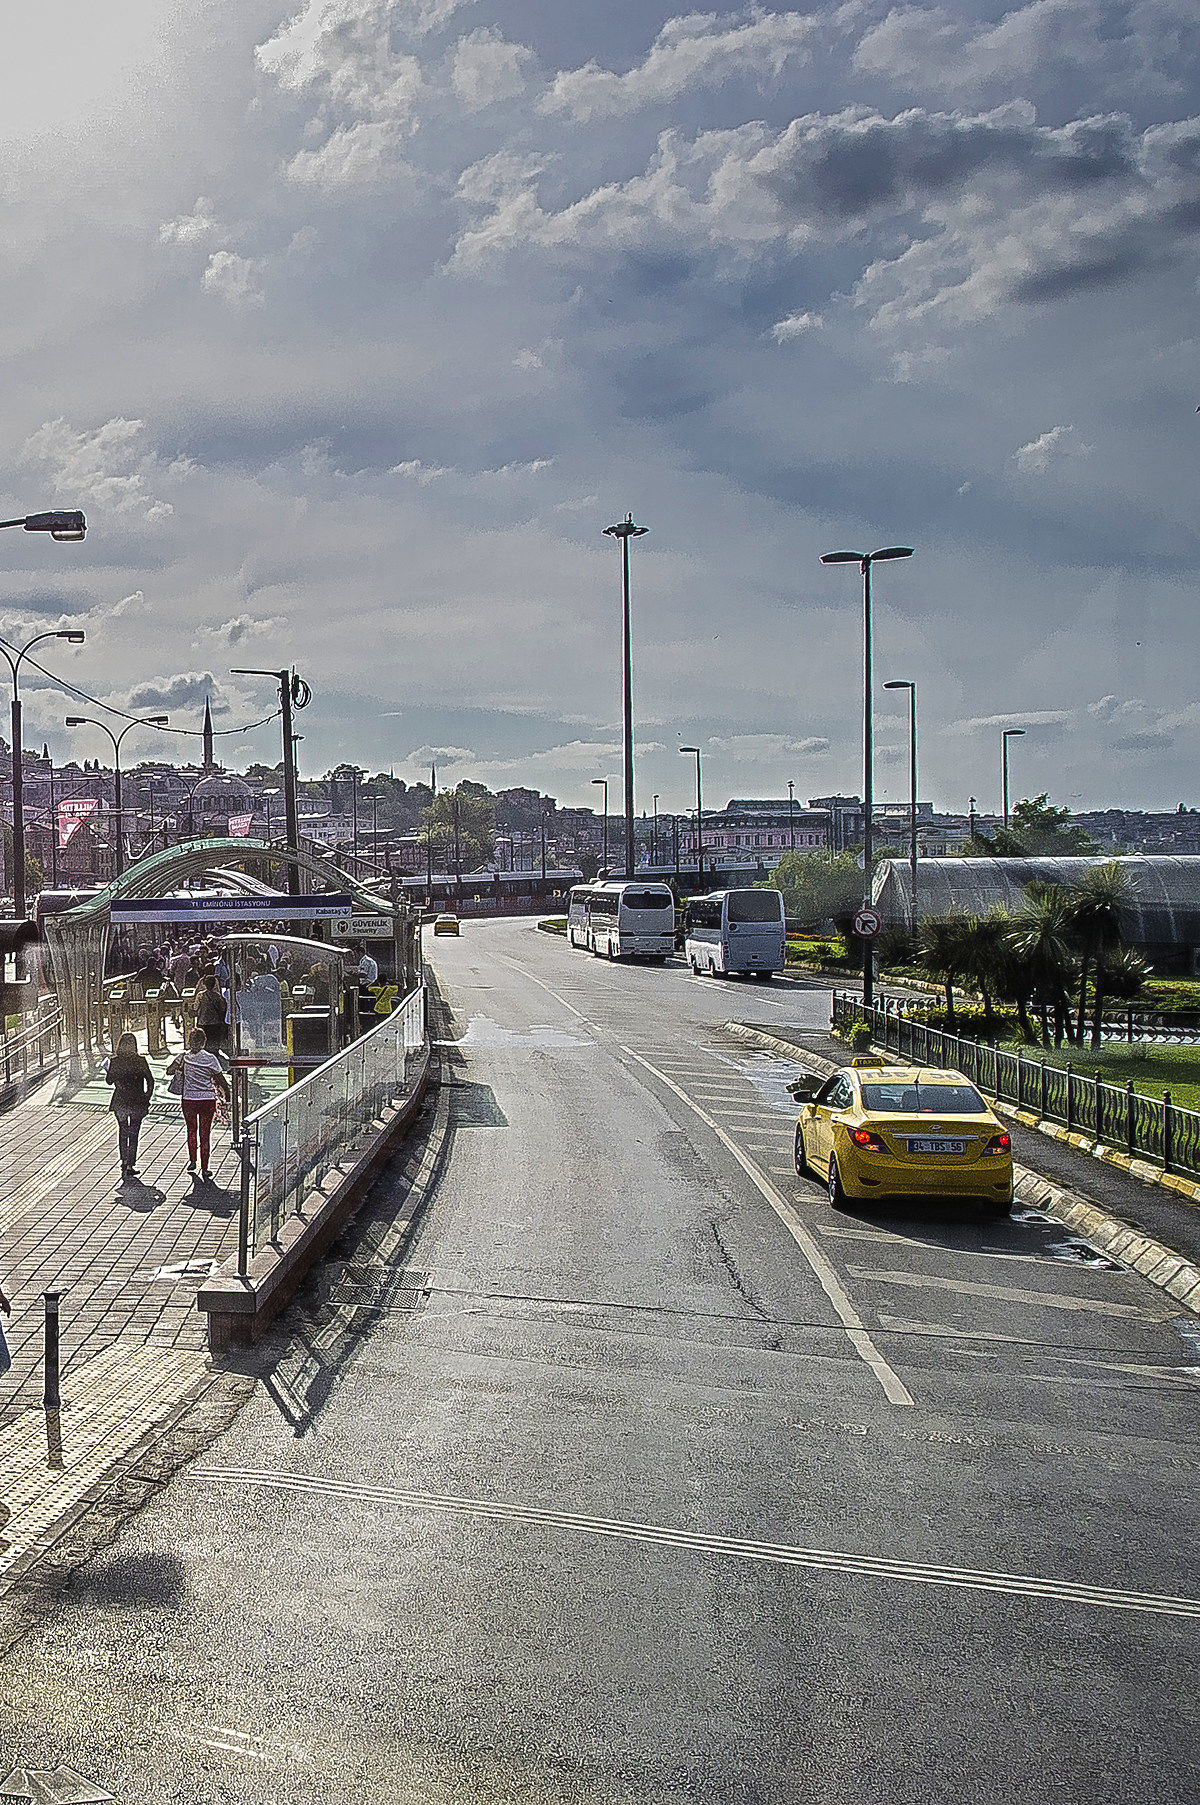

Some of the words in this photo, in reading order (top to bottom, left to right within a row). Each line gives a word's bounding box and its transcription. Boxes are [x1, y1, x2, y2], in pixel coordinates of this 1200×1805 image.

[352, 919, 388, 928] GÜVENLİK
[913, 1141, 925, 1151] 34
[929, 1141, 946, 1151] TBS
[950, 1141, 962, 1152] 56
